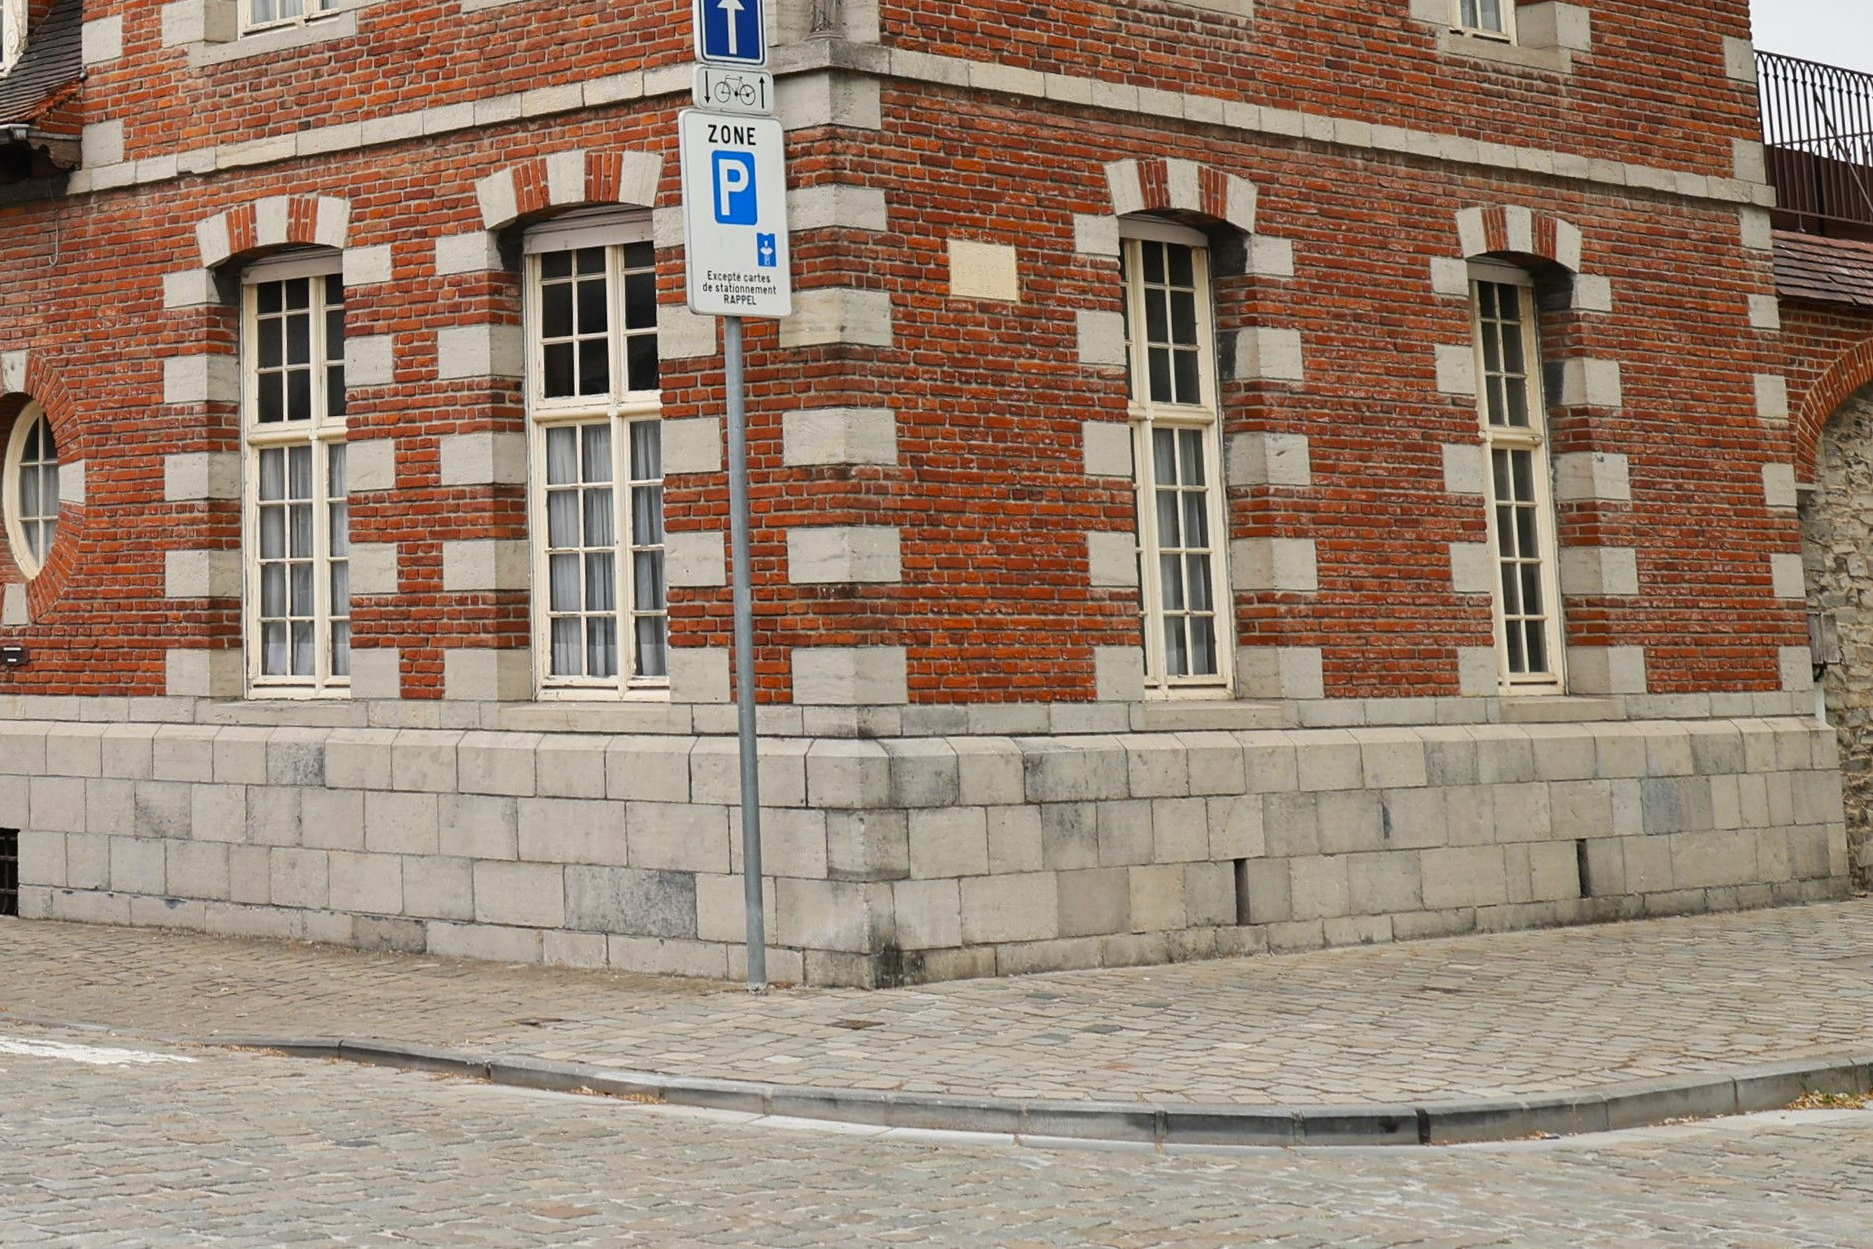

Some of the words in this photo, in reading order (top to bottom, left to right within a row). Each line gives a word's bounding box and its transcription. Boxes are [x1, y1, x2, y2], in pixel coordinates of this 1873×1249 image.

[708, 124, 757, 146] ZONE
[718, 158, 750, 216] P
[707, 270, 741, 283] Excepté
[743, 273, 772, 283] cartes
[702, 282, 713, 292] de
[715, 283, 777, 294] stationnement
[723, 294, 757, 306] RAPPEL
